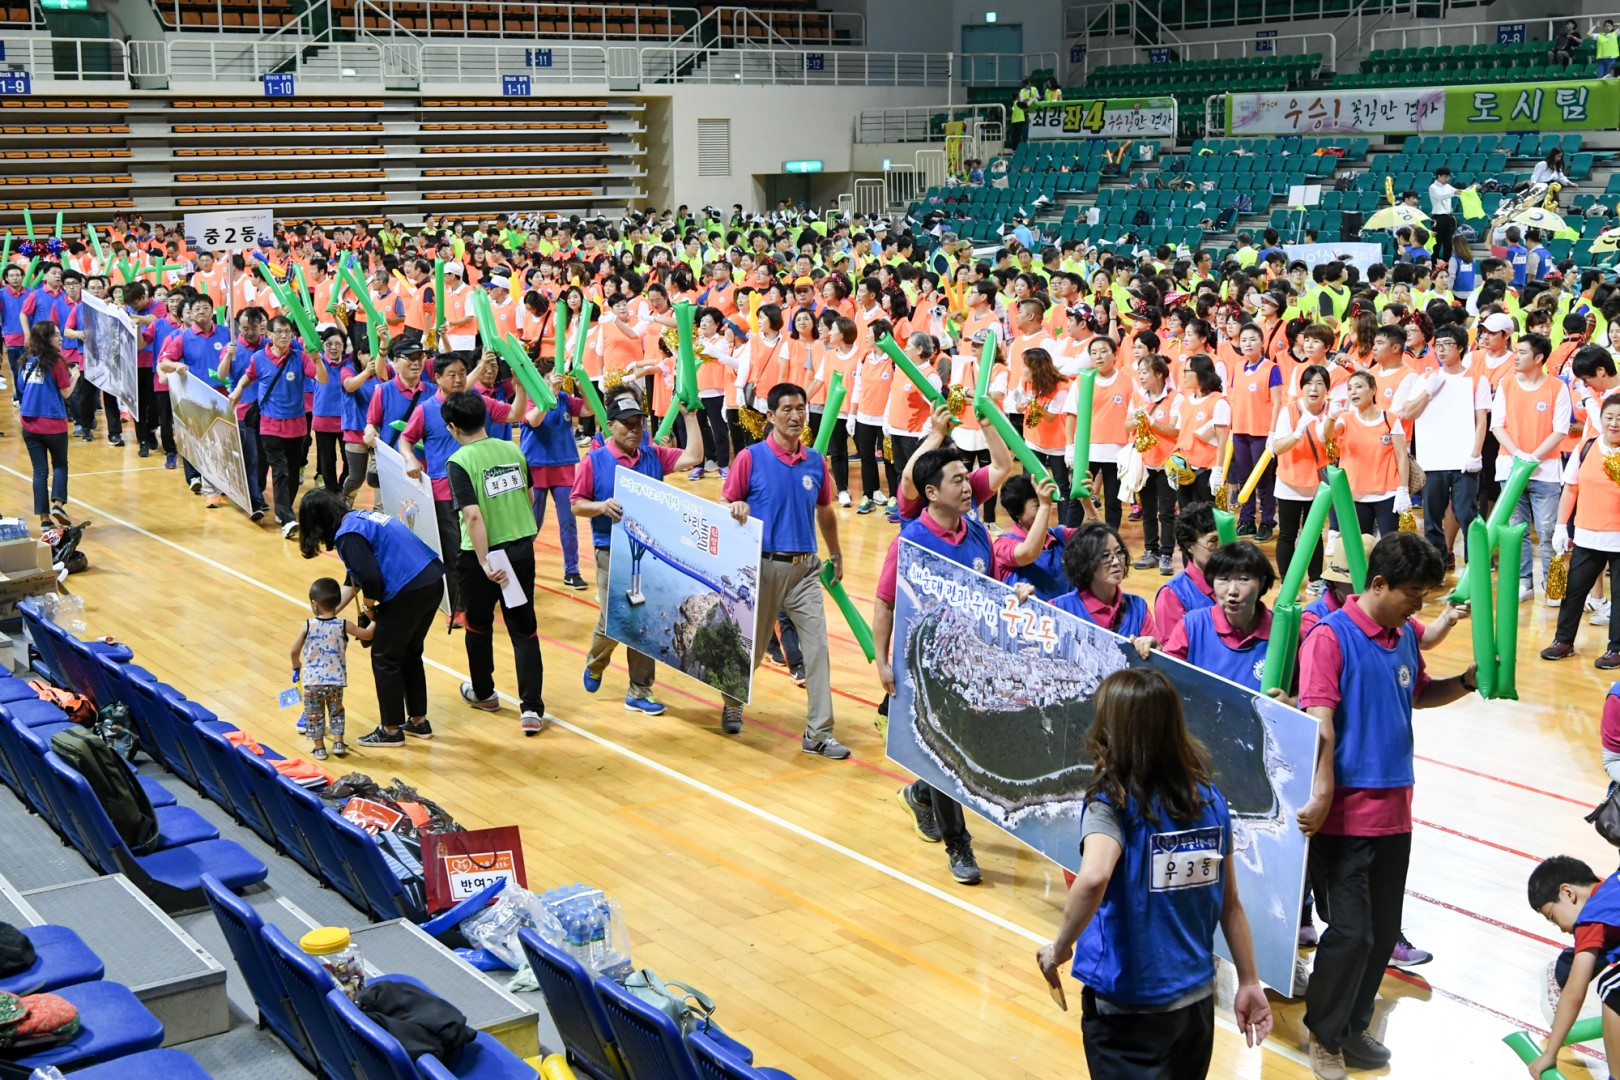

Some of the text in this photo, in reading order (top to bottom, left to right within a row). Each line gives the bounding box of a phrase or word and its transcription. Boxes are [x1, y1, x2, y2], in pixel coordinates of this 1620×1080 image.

[0, 80, 25, 93] 1-9
[267, 82, 292, 94] 1-10
[507, 84, 526, 95] 1-11
[1284, 97, 1439, 129] 우승! 꽃길만 걷자
[1467, 86, 1589, 122] 도시팀
[1032, 106, 1062, 127] 최강
[1151, 112, 1174, 131] 걷자
[910, 565, 1056, 649] 해운대 관광 중심 중2동
[460, 875, 505, 893] 반여
